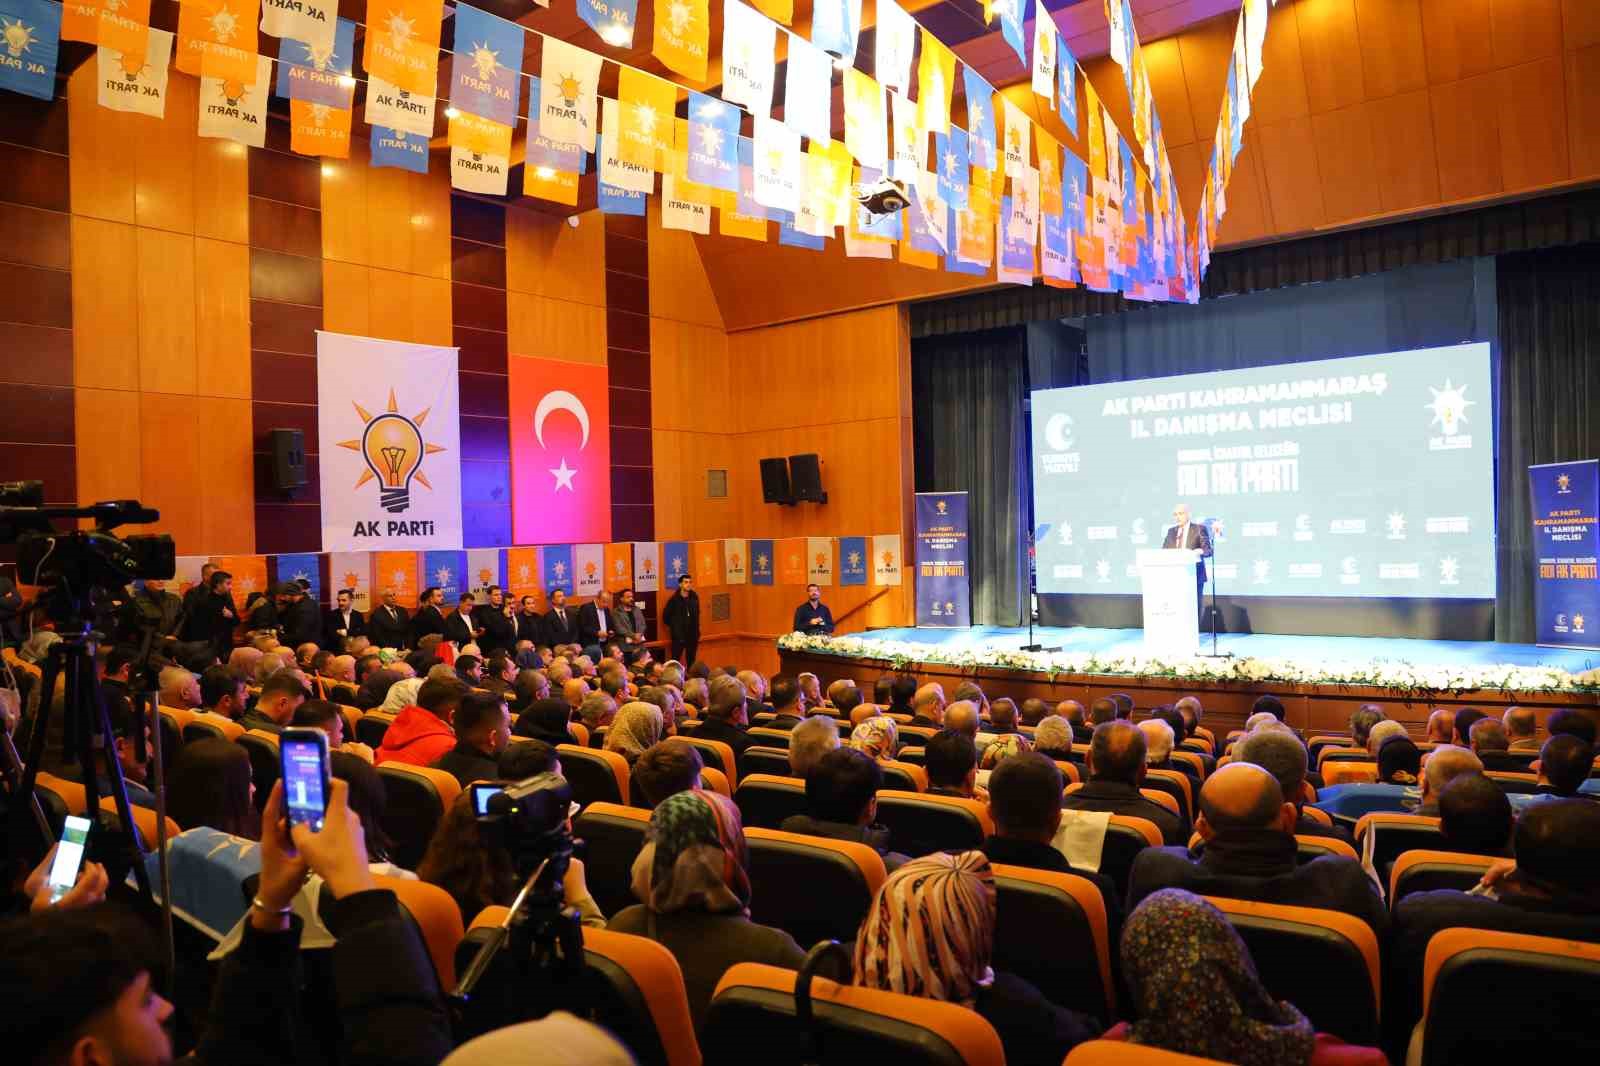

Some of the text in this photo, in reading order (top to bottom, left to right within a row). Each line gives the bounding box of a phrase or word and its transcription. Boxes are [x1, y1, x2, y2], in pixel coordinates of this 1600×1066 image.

[376, 94, 393, 106] AK
[607, 157, 619, 168] AK
[1101, 397, 1129, 416] AK
[353, 520, 381, 538] AK
